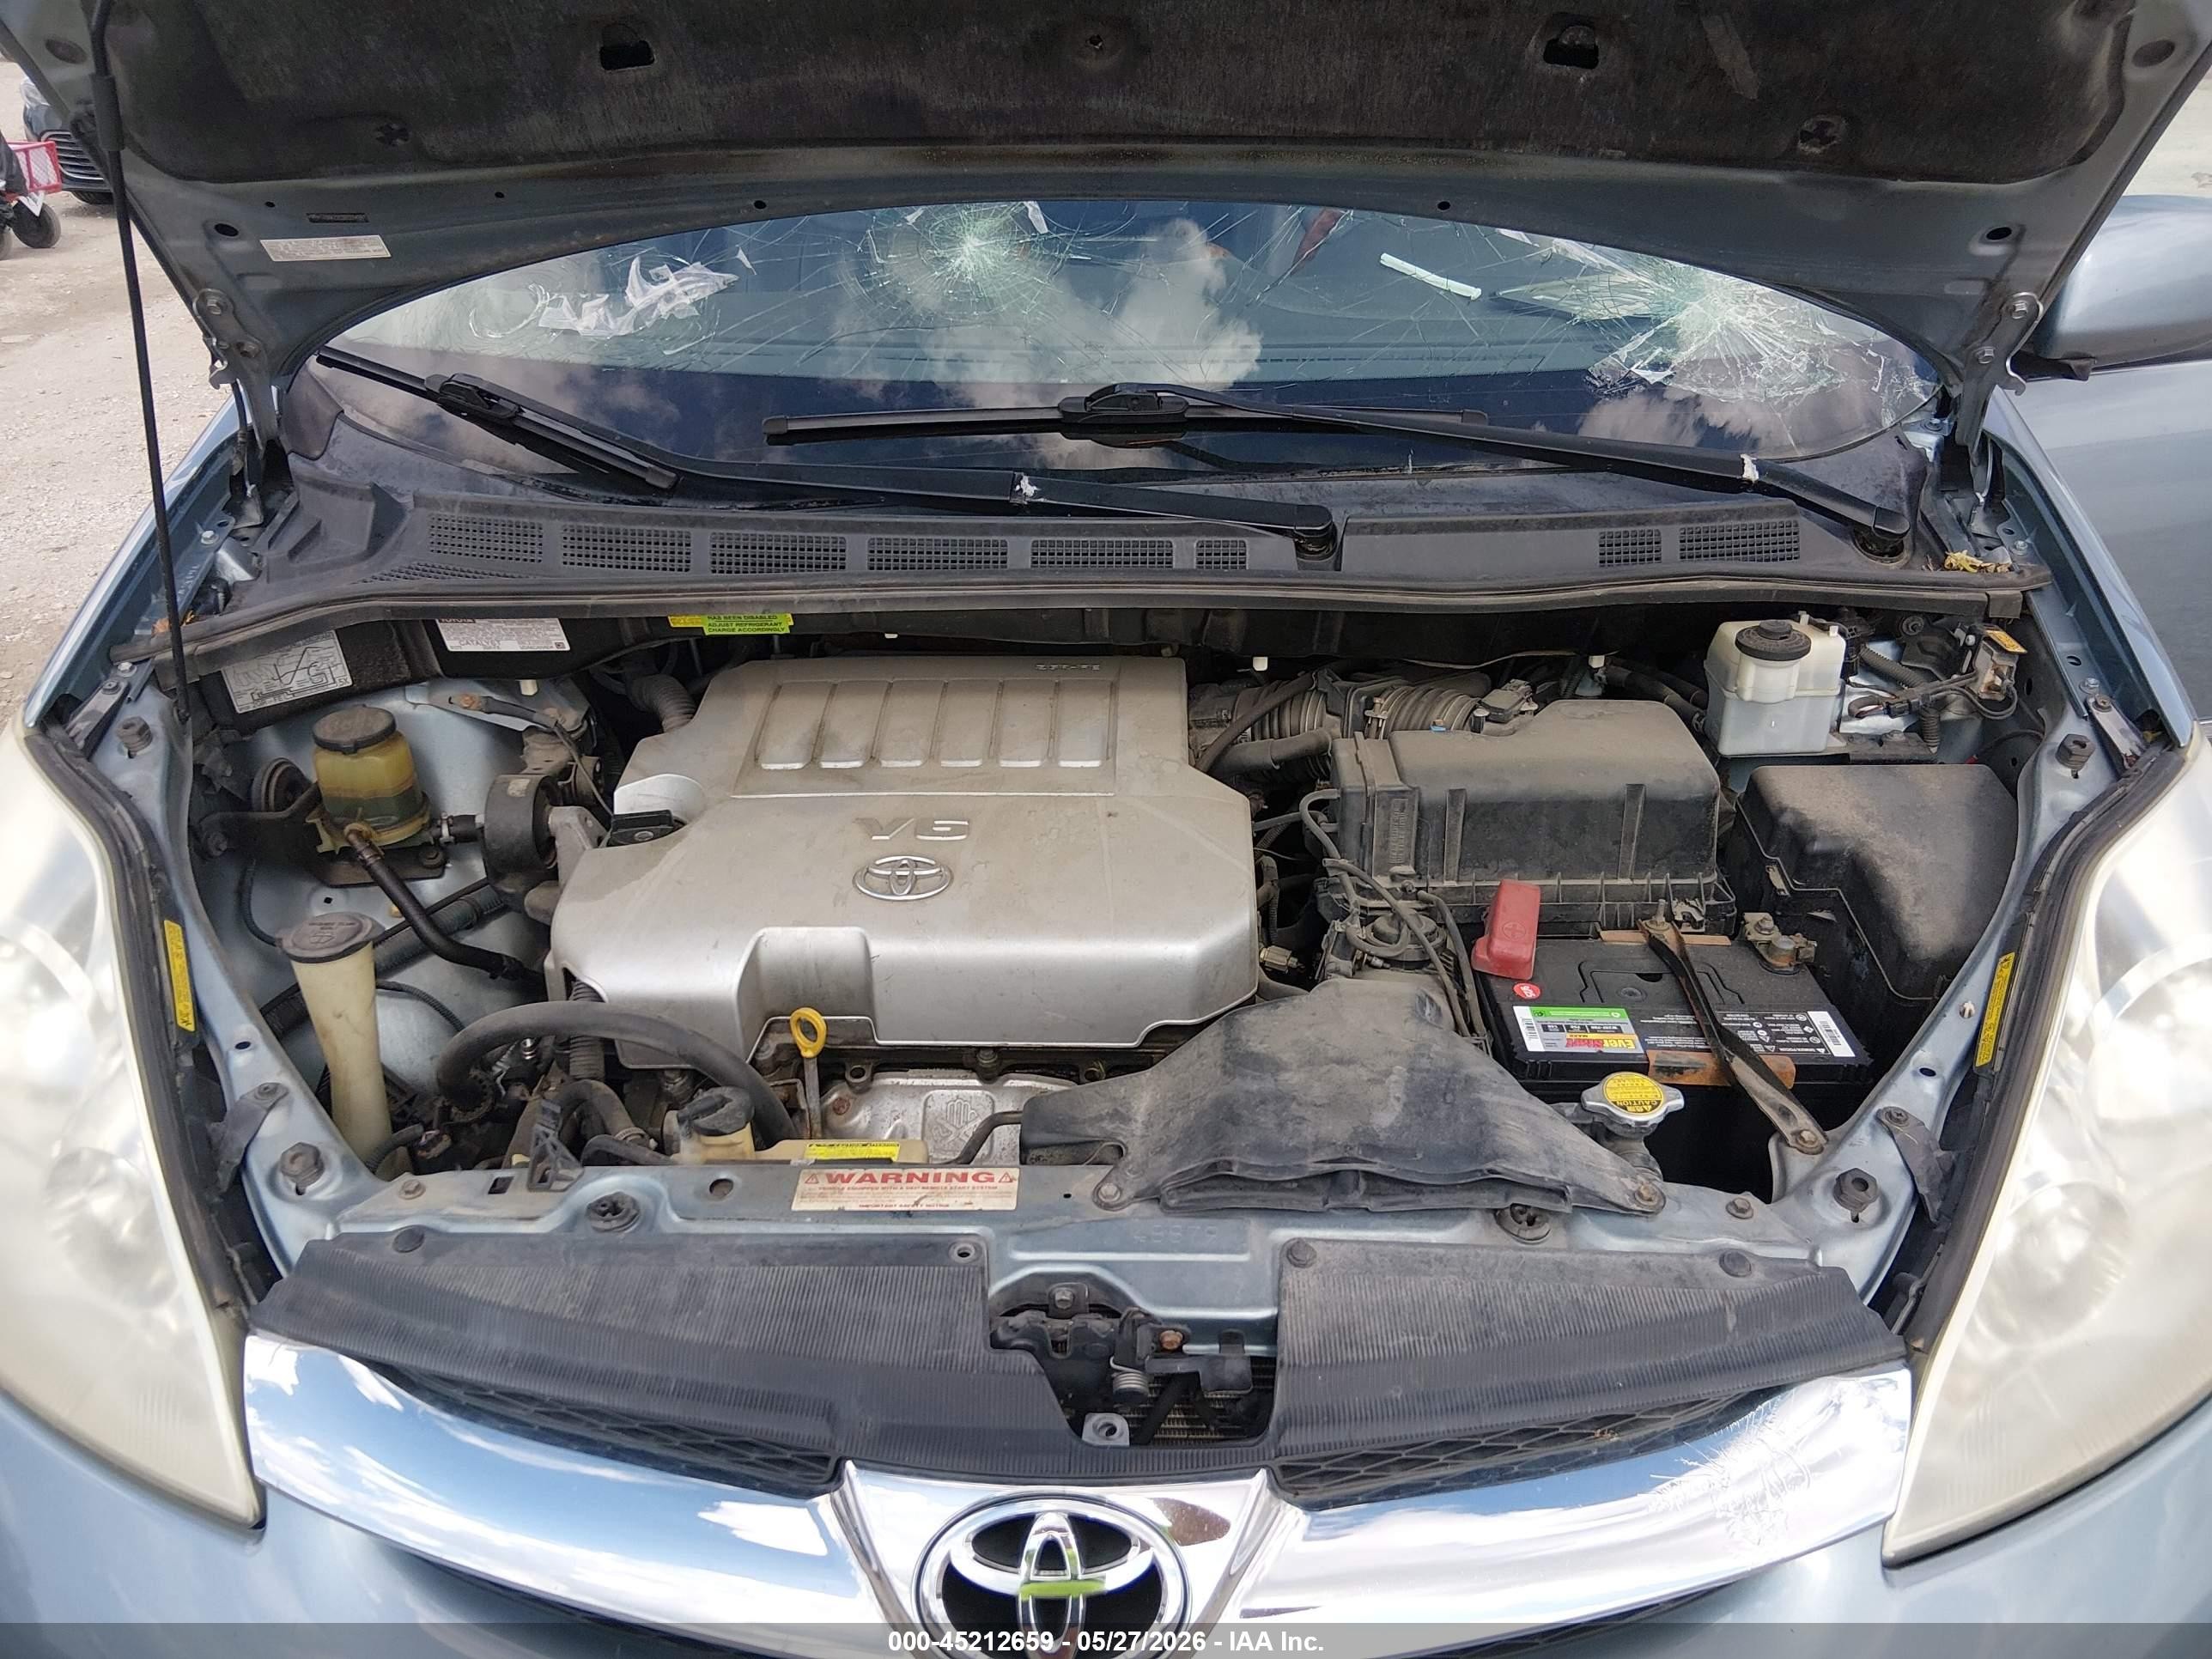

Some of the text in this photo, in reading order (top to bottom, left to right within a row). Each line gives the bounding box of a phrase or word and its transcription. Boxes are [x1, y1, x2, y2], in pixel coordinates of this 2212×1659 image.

[852, 817, 971, 842] V6
[1565, 1037, 1637, 1049] EverStart
[824, 1171, 996, 1184] WARNING
